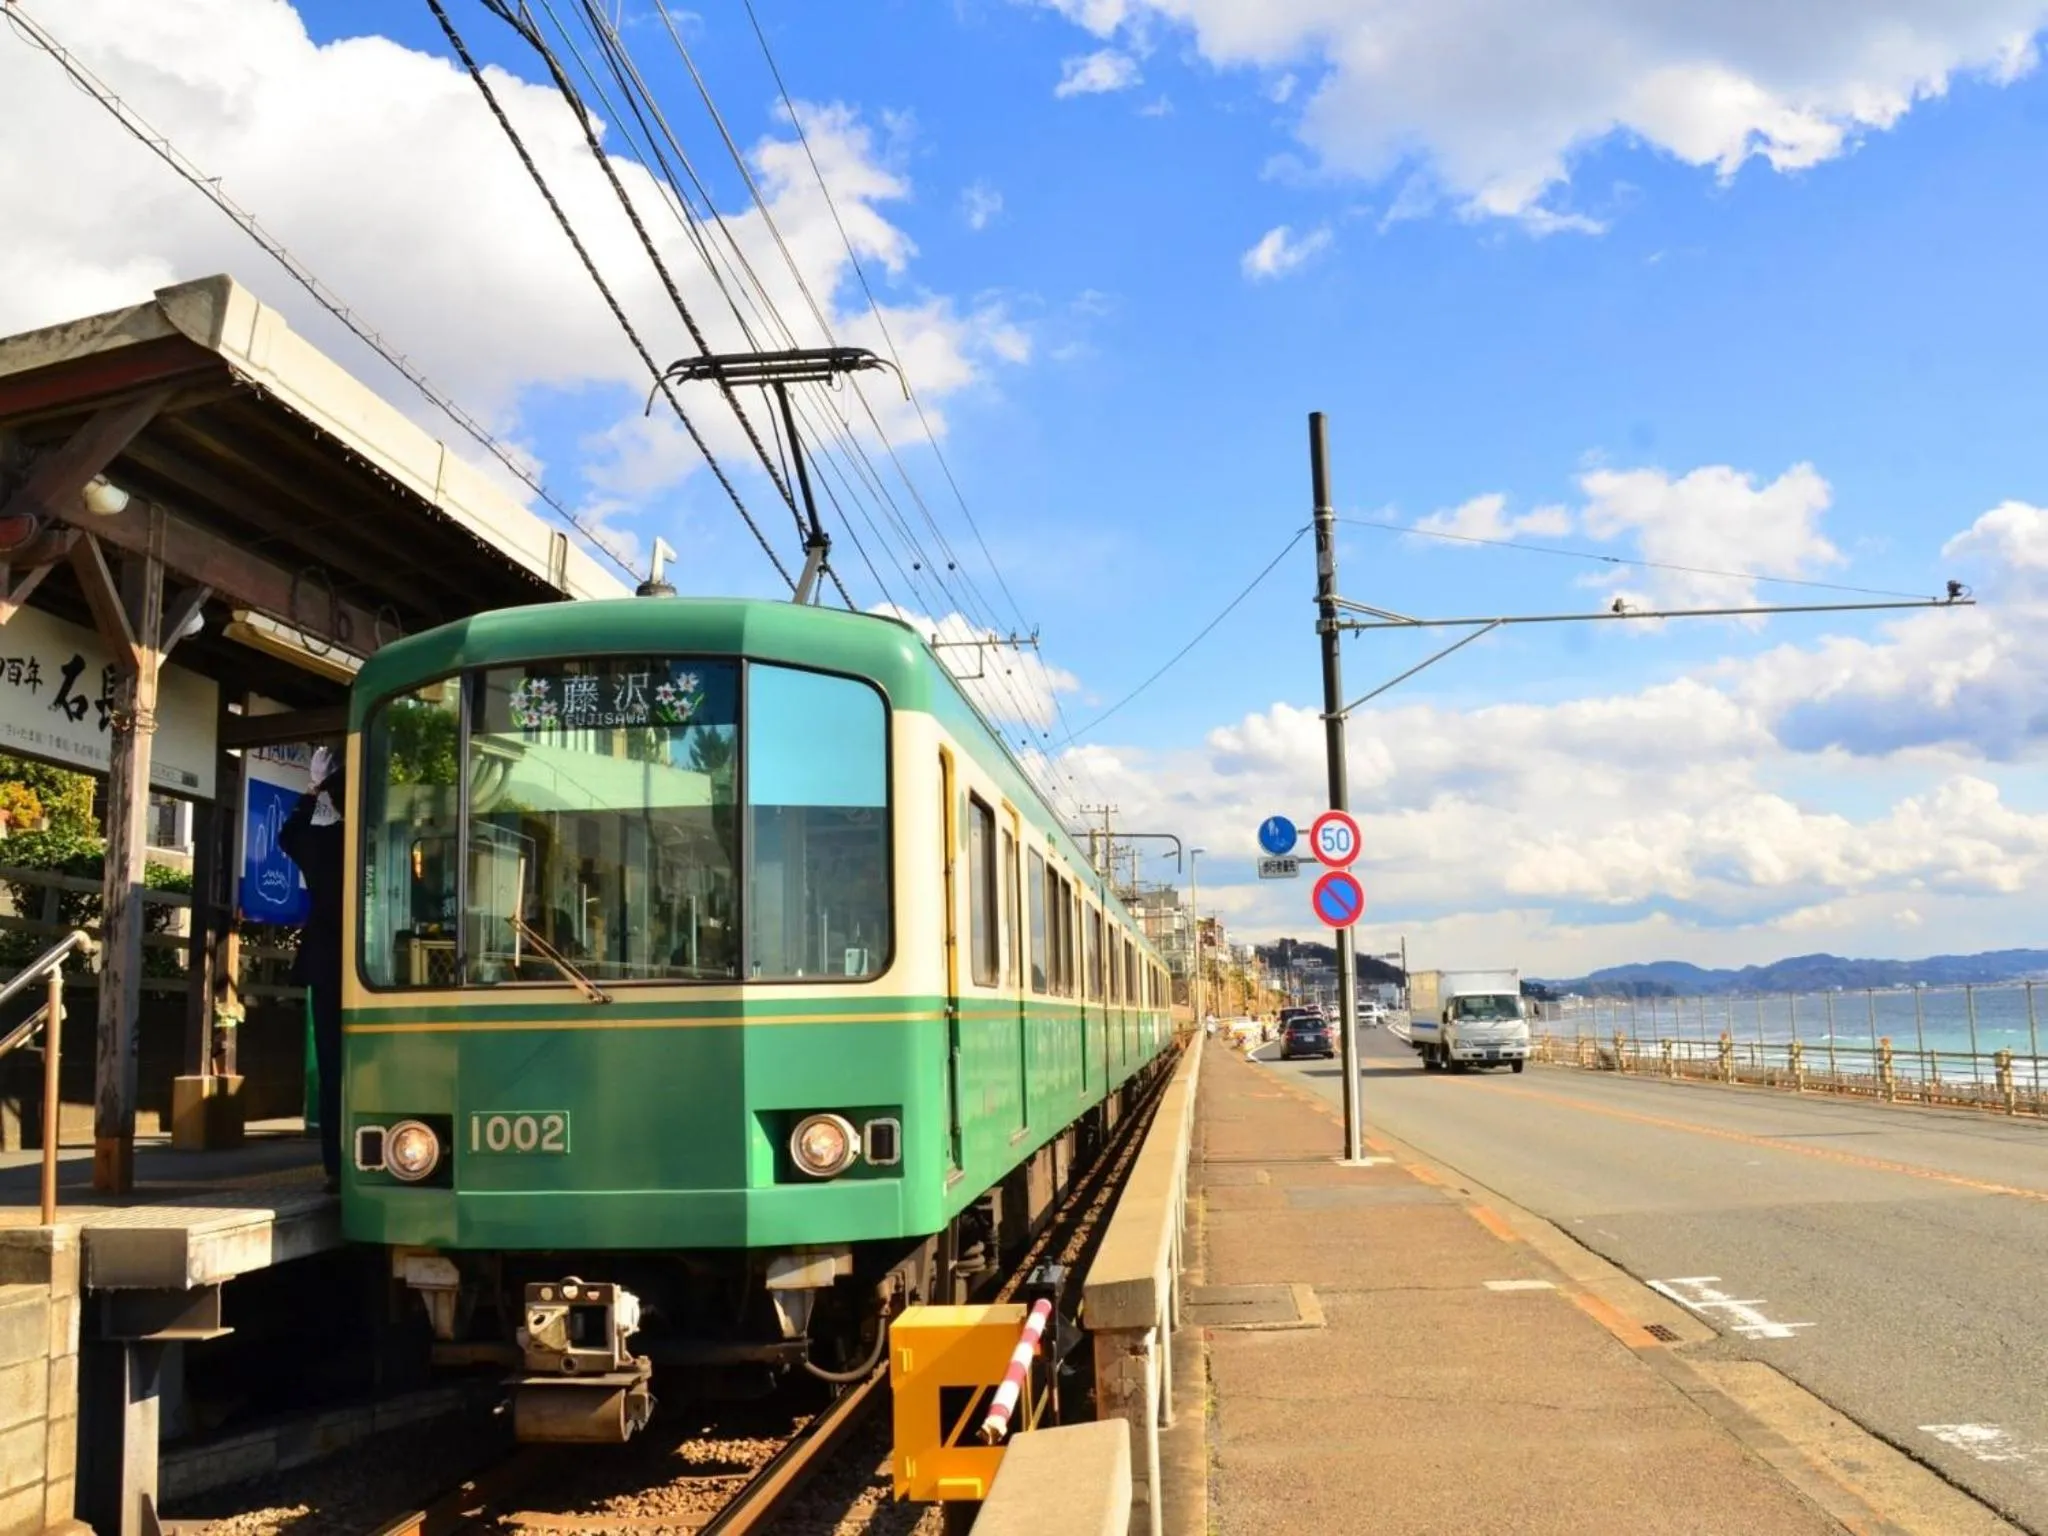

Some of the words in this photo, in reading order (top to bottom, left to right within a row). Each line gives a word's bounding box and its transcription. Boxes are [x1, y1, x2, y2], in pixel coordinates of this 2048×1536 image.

[0, 655, 43, 696] 百年
[561, 672, 650, 715] 藤沢
[565, 712, 647, 726] FUJISAWA
[1321, 827, 1350, 853] 50
[471, 1114, 565, 1152] 1002
